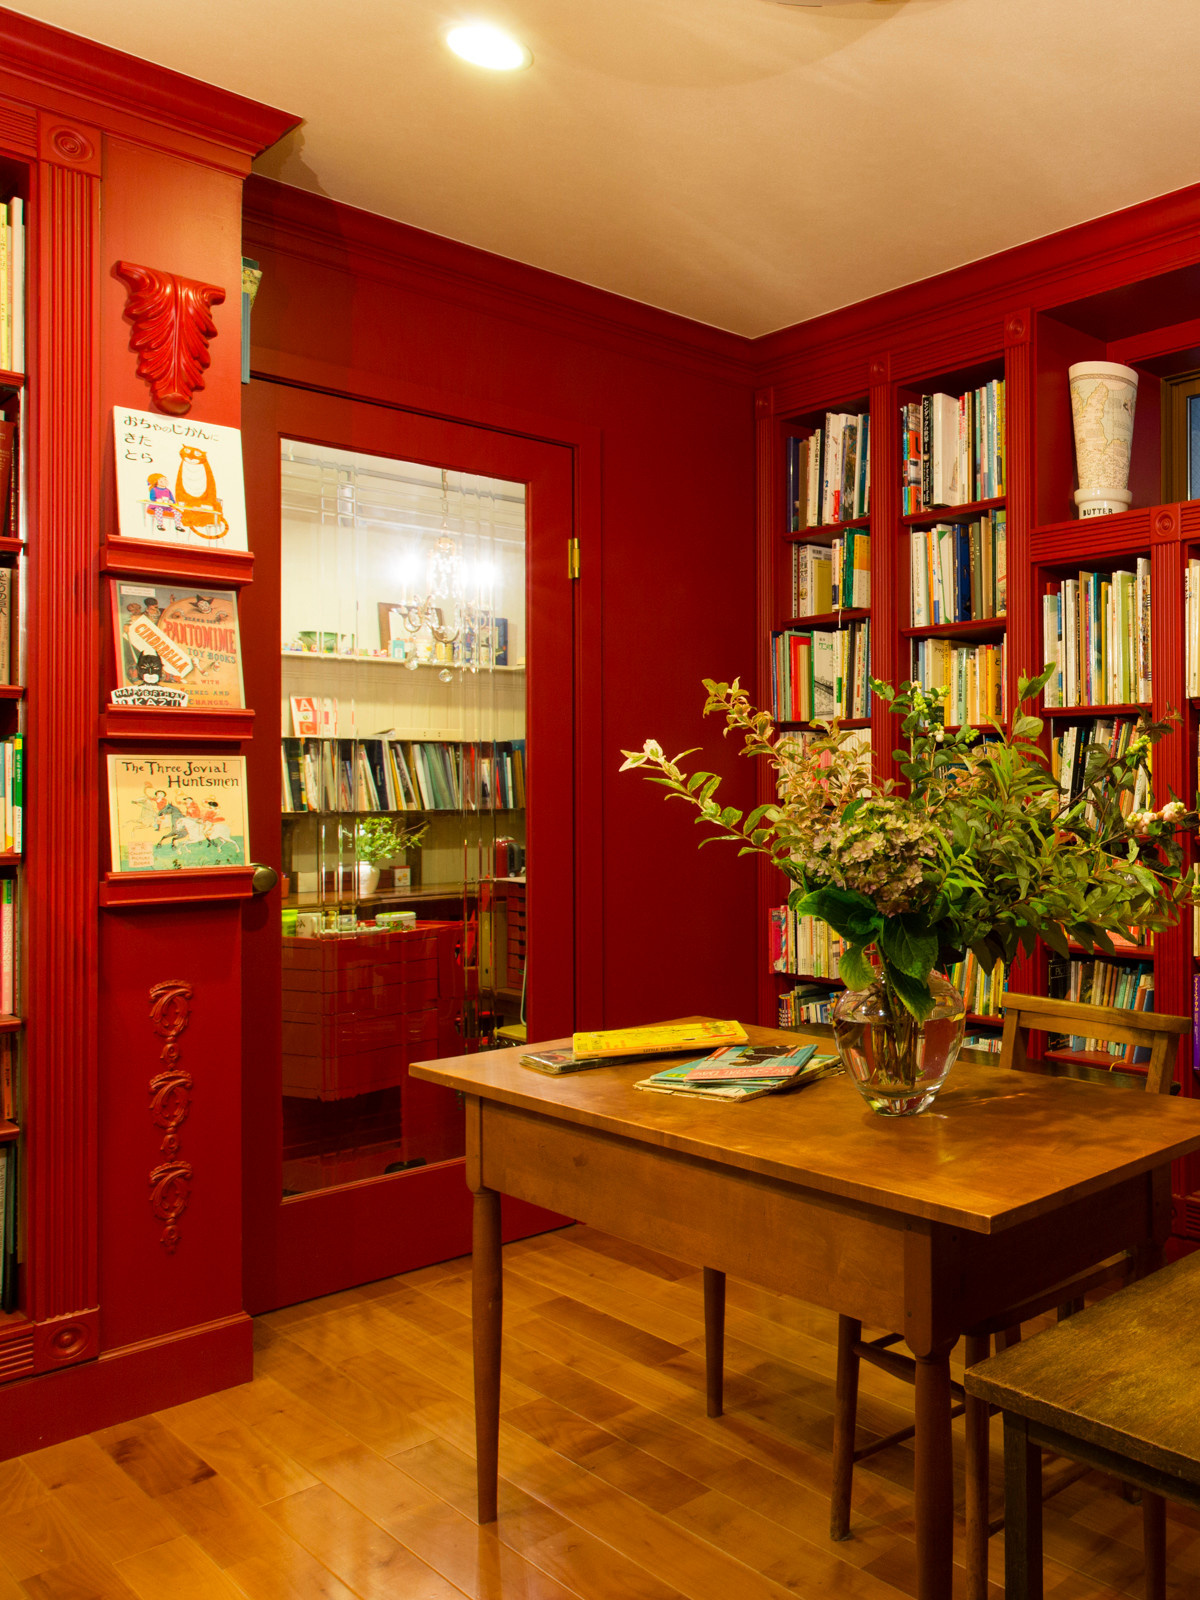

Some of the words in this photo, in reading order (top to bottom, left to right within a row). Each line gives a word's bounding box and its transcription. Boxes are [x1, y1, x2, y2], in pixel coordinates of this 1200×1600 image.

[124, 415, 219, 442] おちゃのじかんに
[124, 432, 153, 447] きた
[124, 448, 154, 464] とら
[1082, 507, 1114, 517] BUTTER
[163, 619, 236, 654] PANTOMIME
[134, 623, 190, 673] CINDERELLA
[187, 648, 207, 659] TOY
[208, 651, 236, 664] BOOKS
[299, 699, 311, 711] A
[122, 762, 145, 774] The
[145, 761, 183, 775] Three
[183, 761, 228, 776] Jovial
[168, 775, 239, 789] Huntsmen
